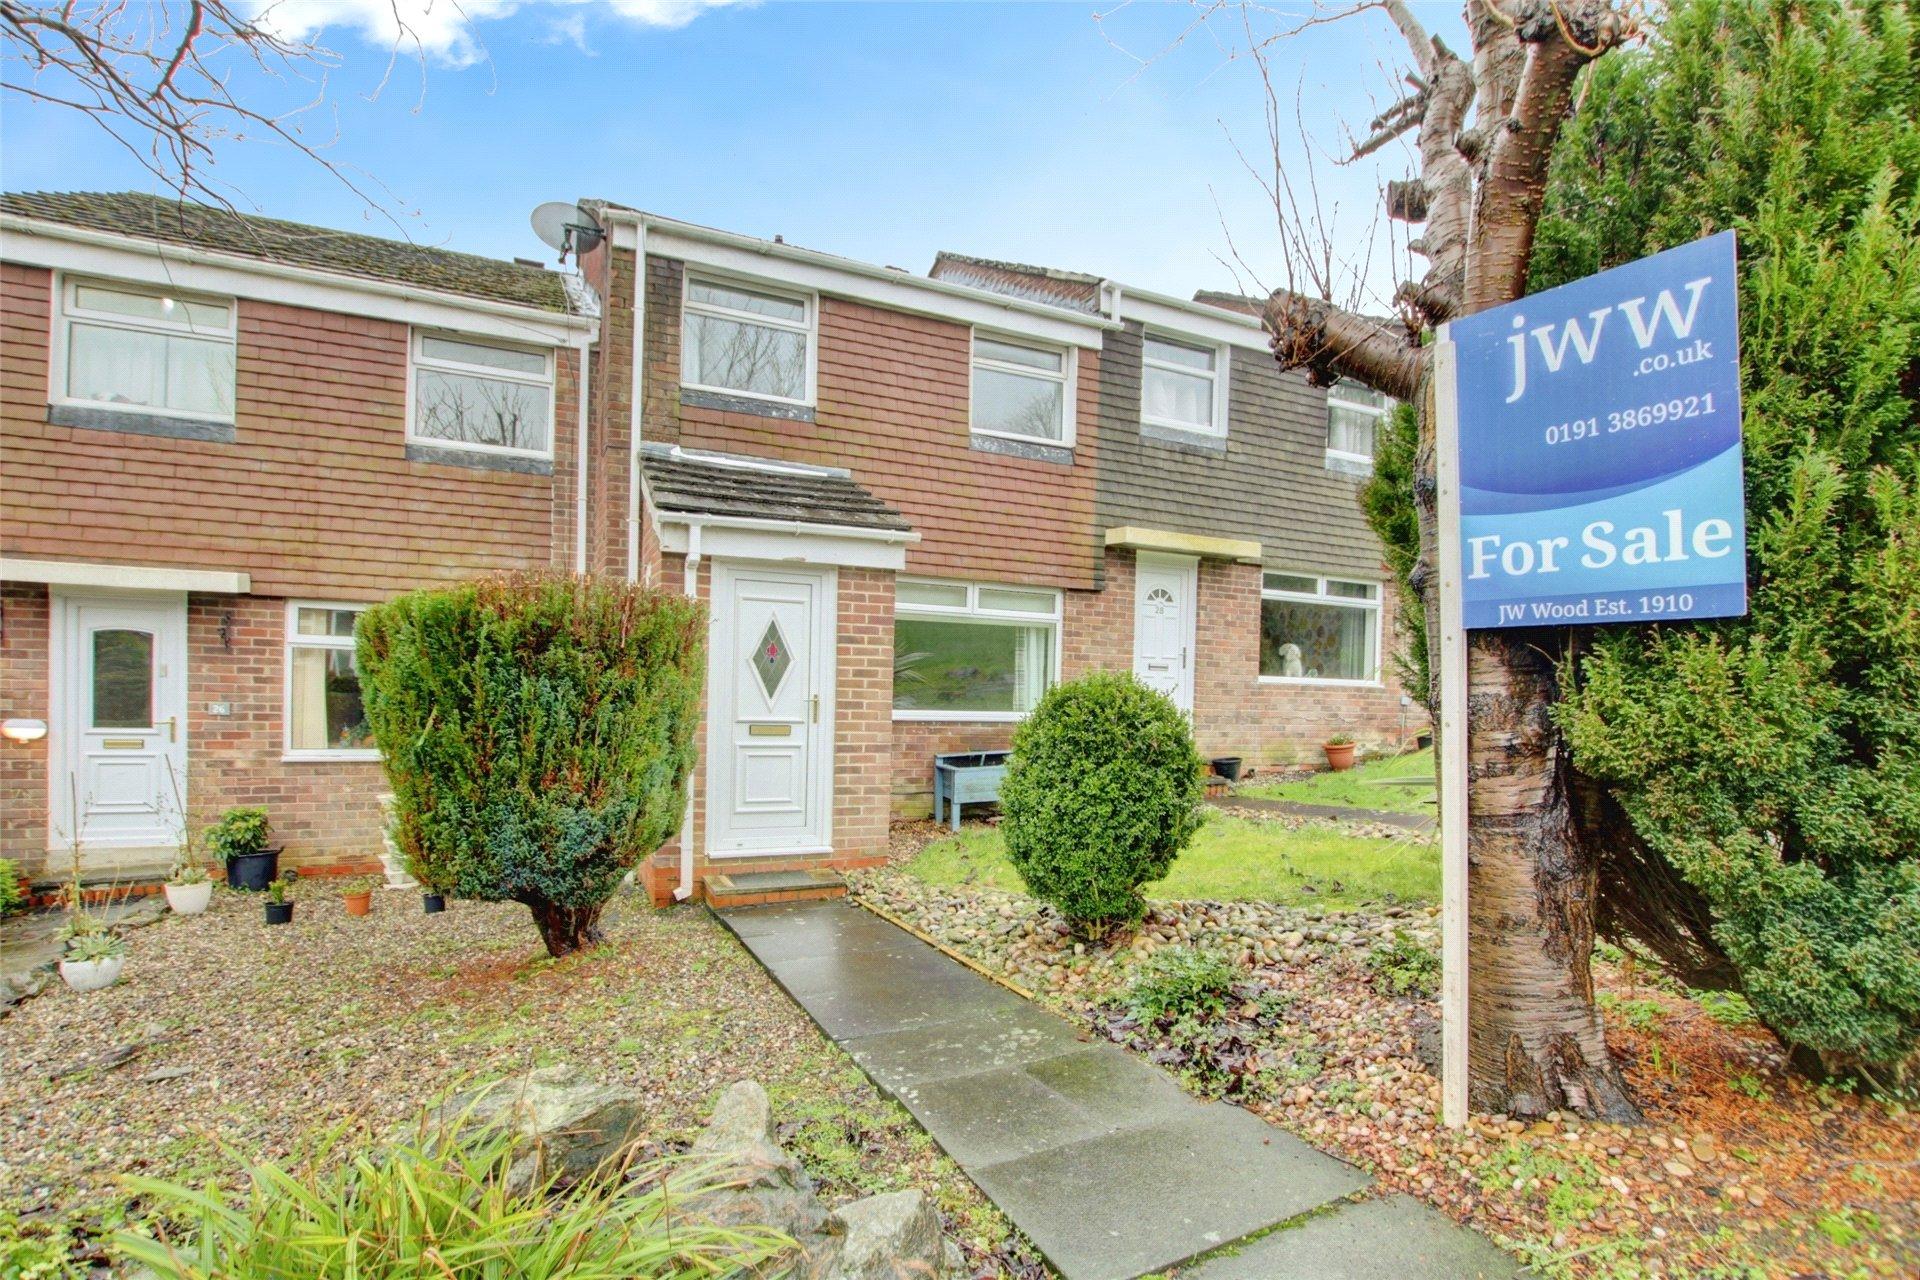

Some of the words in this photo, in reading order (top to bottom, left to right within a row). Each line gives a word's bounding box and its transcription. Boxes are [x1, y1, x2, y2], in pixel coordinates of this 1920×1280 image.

[1506, 276, 1712, 403] jww
[1632, 338, 1713, 376] .co.uk
[1545, 418, 1600, 446] 0191
[1607, 393, 1717, 434] 3869921
[1467, 534, 1569, 580] For
[1581, 508, 1733, 570] Sale
[1155, 606, 1165, 615] 28
[1498, 604, 1525, 625] JW
[1532, 601, 1589, 620] Wood
[1594, 598, 1632, 617] Est.
[1639, 594, 1694, 614] 1910
[212, 704, 226, 713] 26
